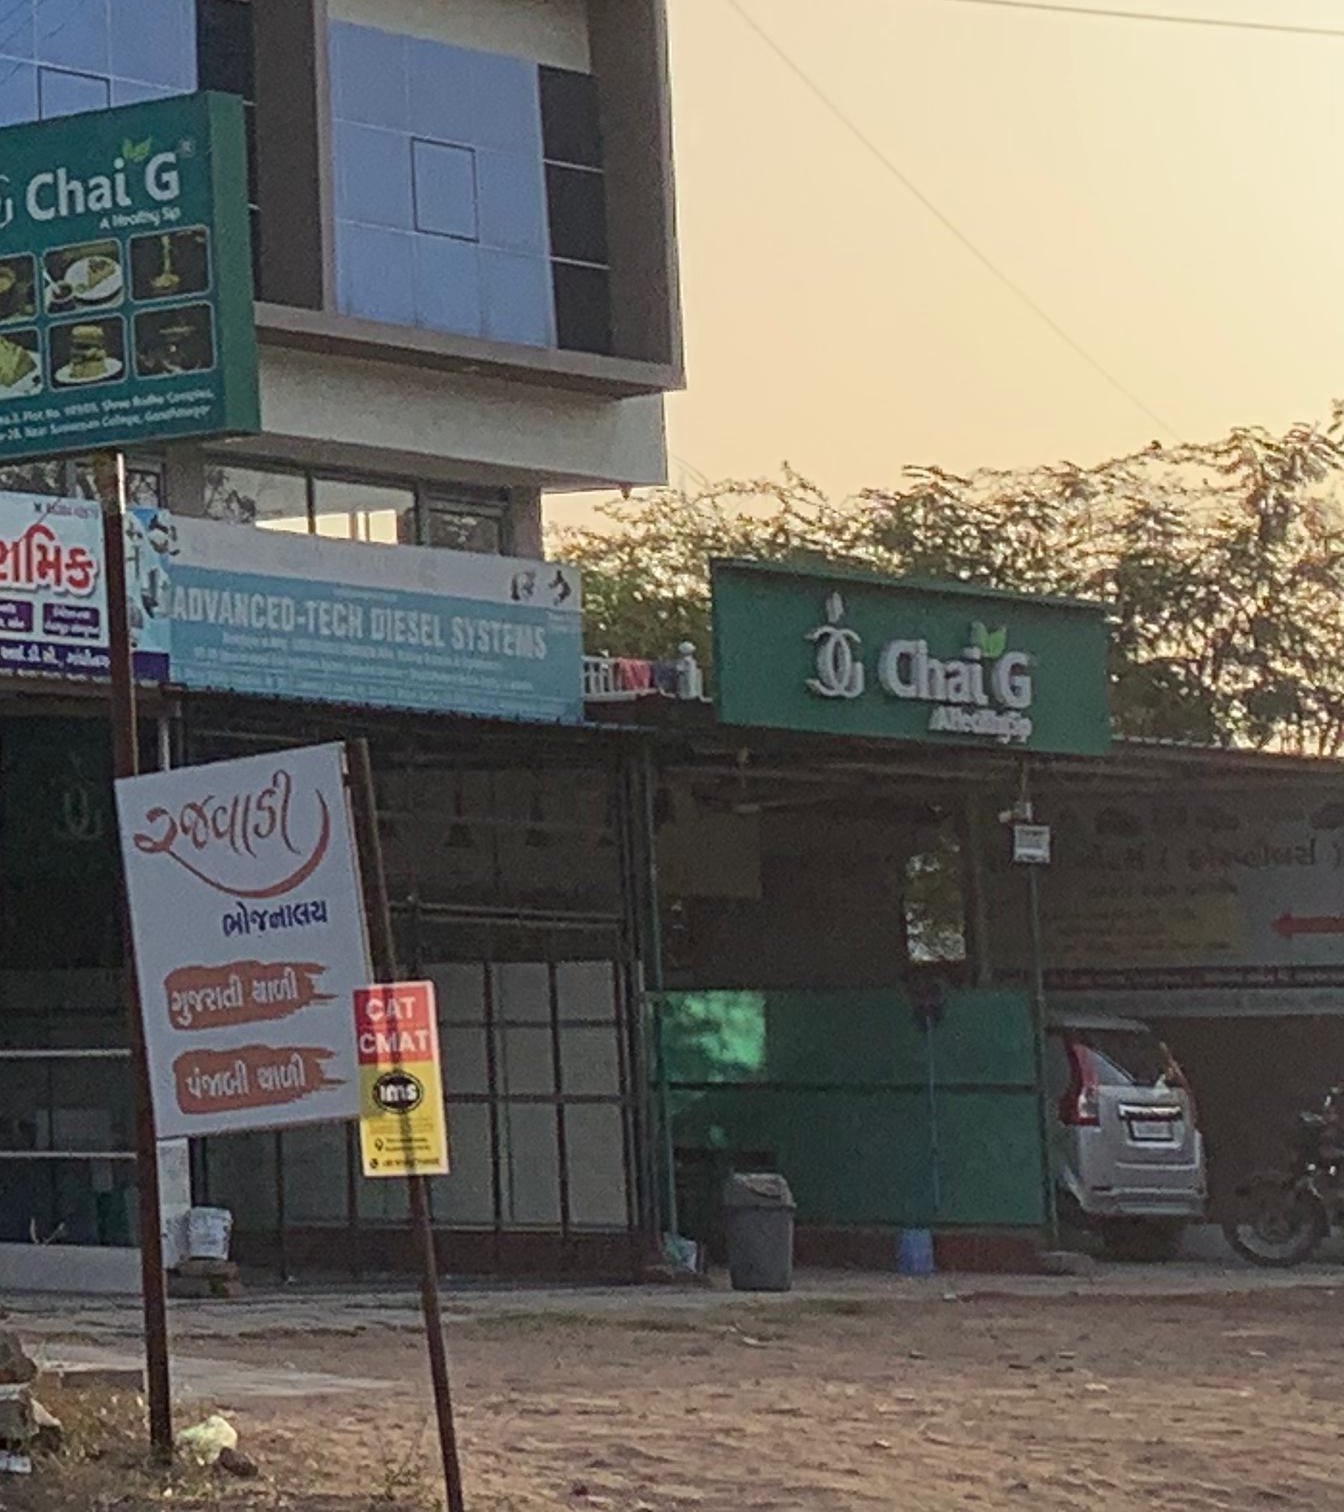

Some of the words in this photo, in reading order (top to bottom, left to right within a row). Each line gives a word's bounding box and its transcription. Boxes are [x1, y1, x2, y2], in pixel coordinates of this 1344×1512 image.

[25, 156, 131, 222] Chai
[144, 151, 181, 202] G
[173, 586, 364, 639] ADVANCED-TECH
[370, 607, 445, 648] DIESEL
[451, 615, 548, 660] SYSTEMS
[879, 639, 989, 706] Chai
[992, 651, 1031, 709] G
[132, 769, 331, 899] રજવાડી
[222, 899, 329, 937] ભોજનાલય
[359, 1029, 430, 1054] CMAT
[366, 996, 417, 1022] CAT
